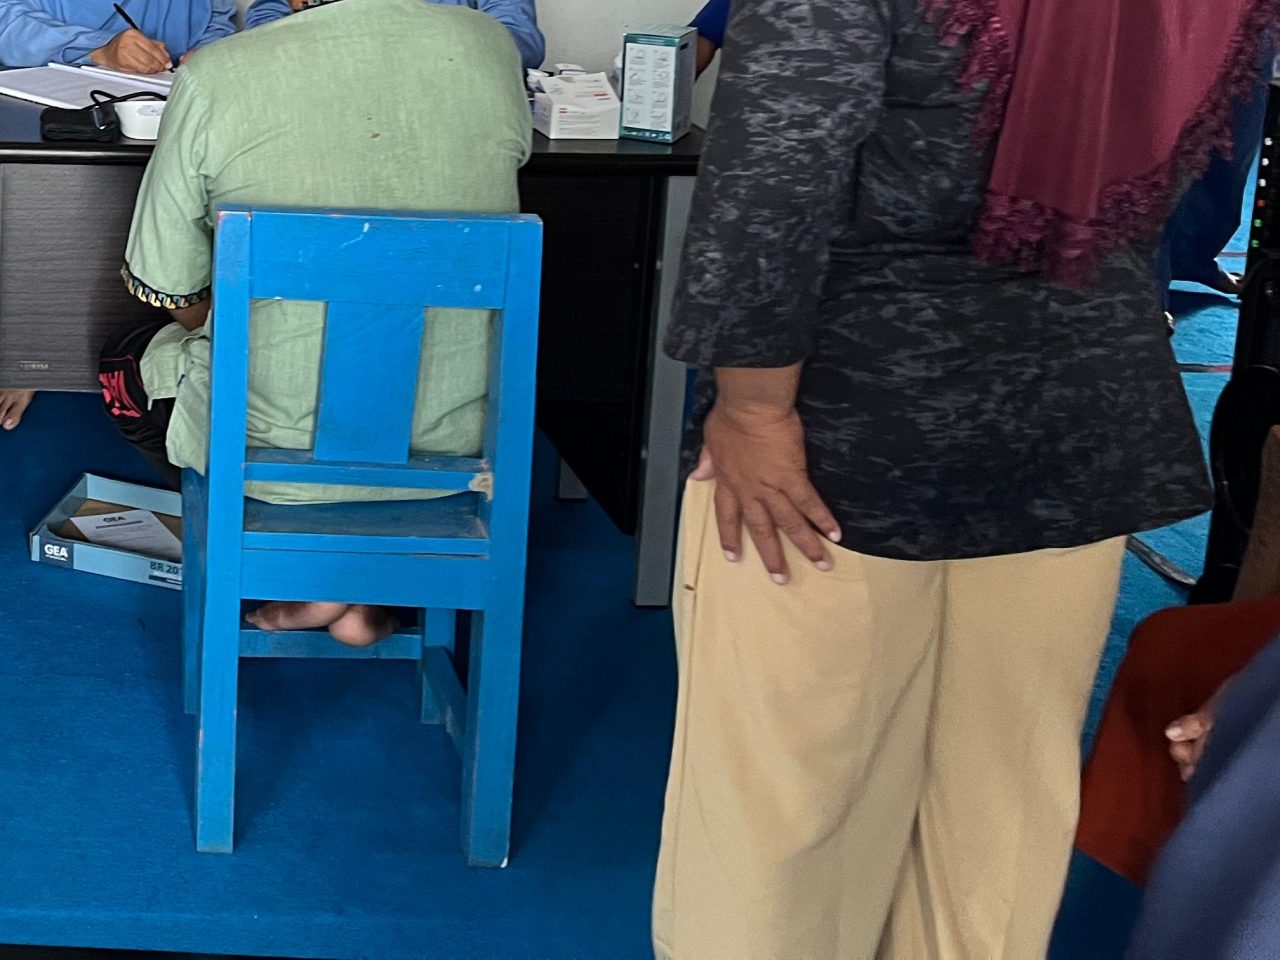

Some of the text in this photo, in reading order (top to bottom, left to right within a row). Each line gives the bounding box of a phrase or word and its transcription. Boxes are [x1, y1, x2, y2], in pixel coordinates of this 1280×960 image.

[44, 544, 69, 558] GEA
[150, 561, 182, 575] BR 20
